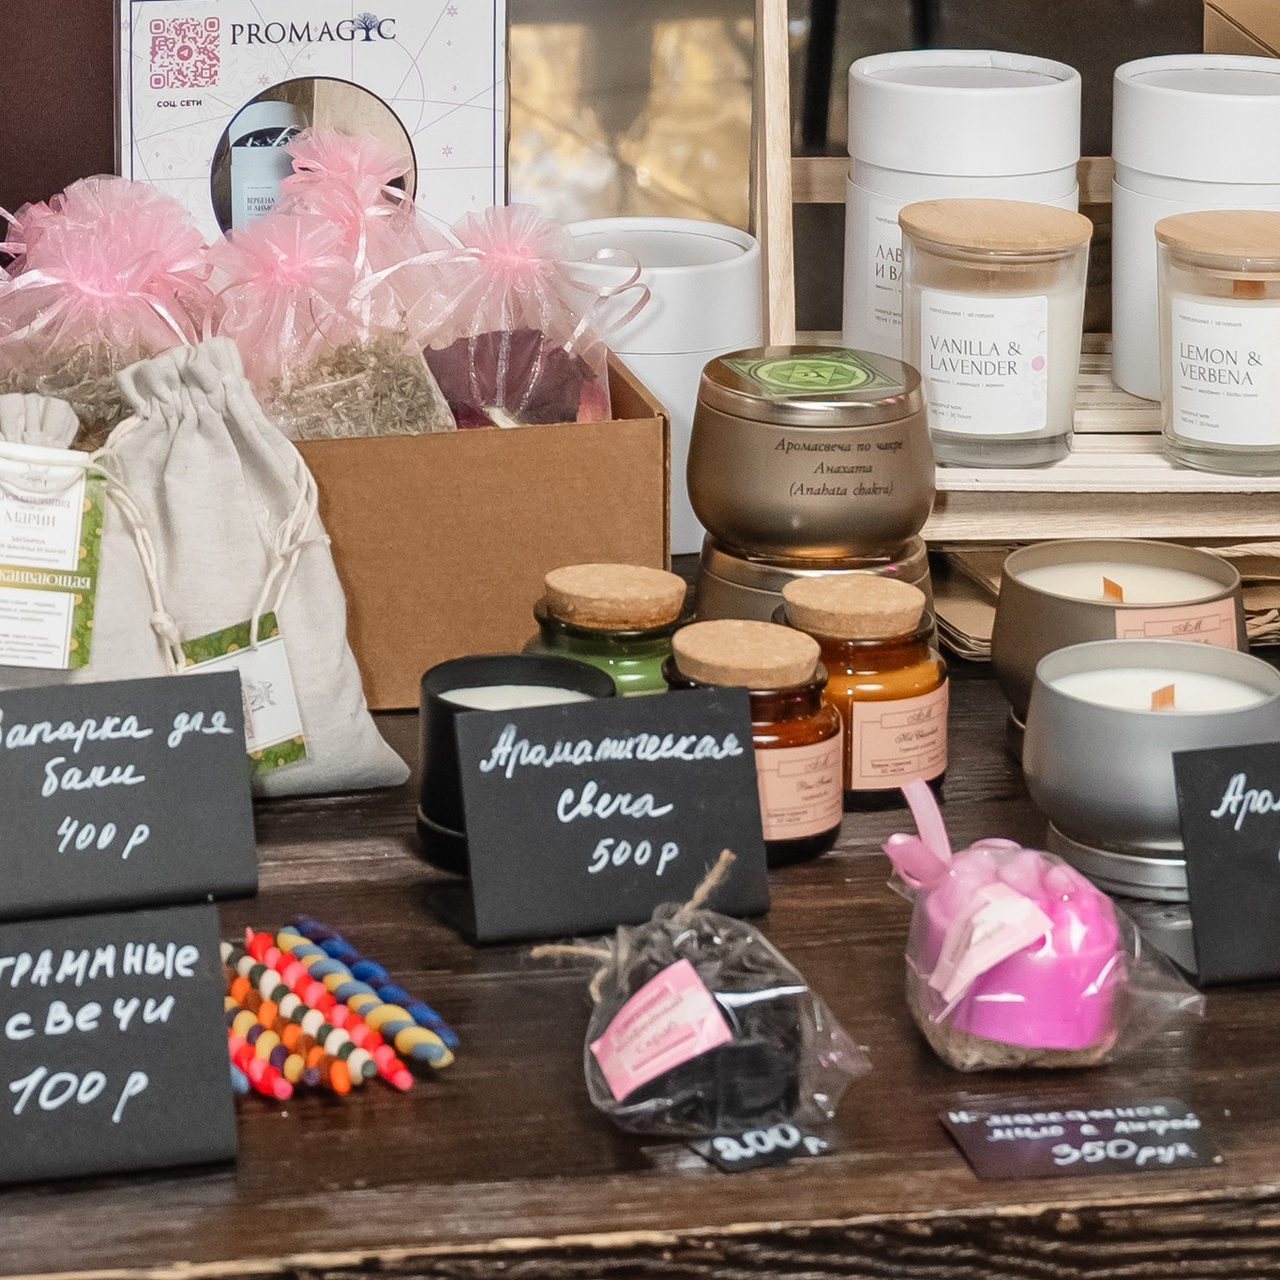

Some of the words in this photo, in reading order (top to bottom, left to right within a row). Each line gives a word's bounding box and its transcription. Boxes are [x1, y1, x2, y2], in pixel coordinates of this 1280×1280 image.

[230, 12, 397, 46] PROMAGIC
[179, 99, 203, 107] СЕТИ
[875, 262, 885, 279] И
[929, 334, 1000, 357] VANILLA
[1007, 341, 1023, 357] &
[1180, 342, 1238, 365] LEMON
[1246, 350, 1263, 367] &
[930, 354, 1018, 376] LAVENDER
[1180, 361, 1254, 386] VERBENA
[774, 438, 852, 453] Аромасвеча
[856, 442, 871, 452] по
[813, 461, 873, 474] Анахата
[789, 481, 847, 497] (Anahata
[852, 481, 895, 497] chakra)
[167, 710, 234, 749] для
[479, 724, 744, 779] Ароматическая
[41, 756, 146, 798] бани
[1210, 772, 1280, 831] Аро
